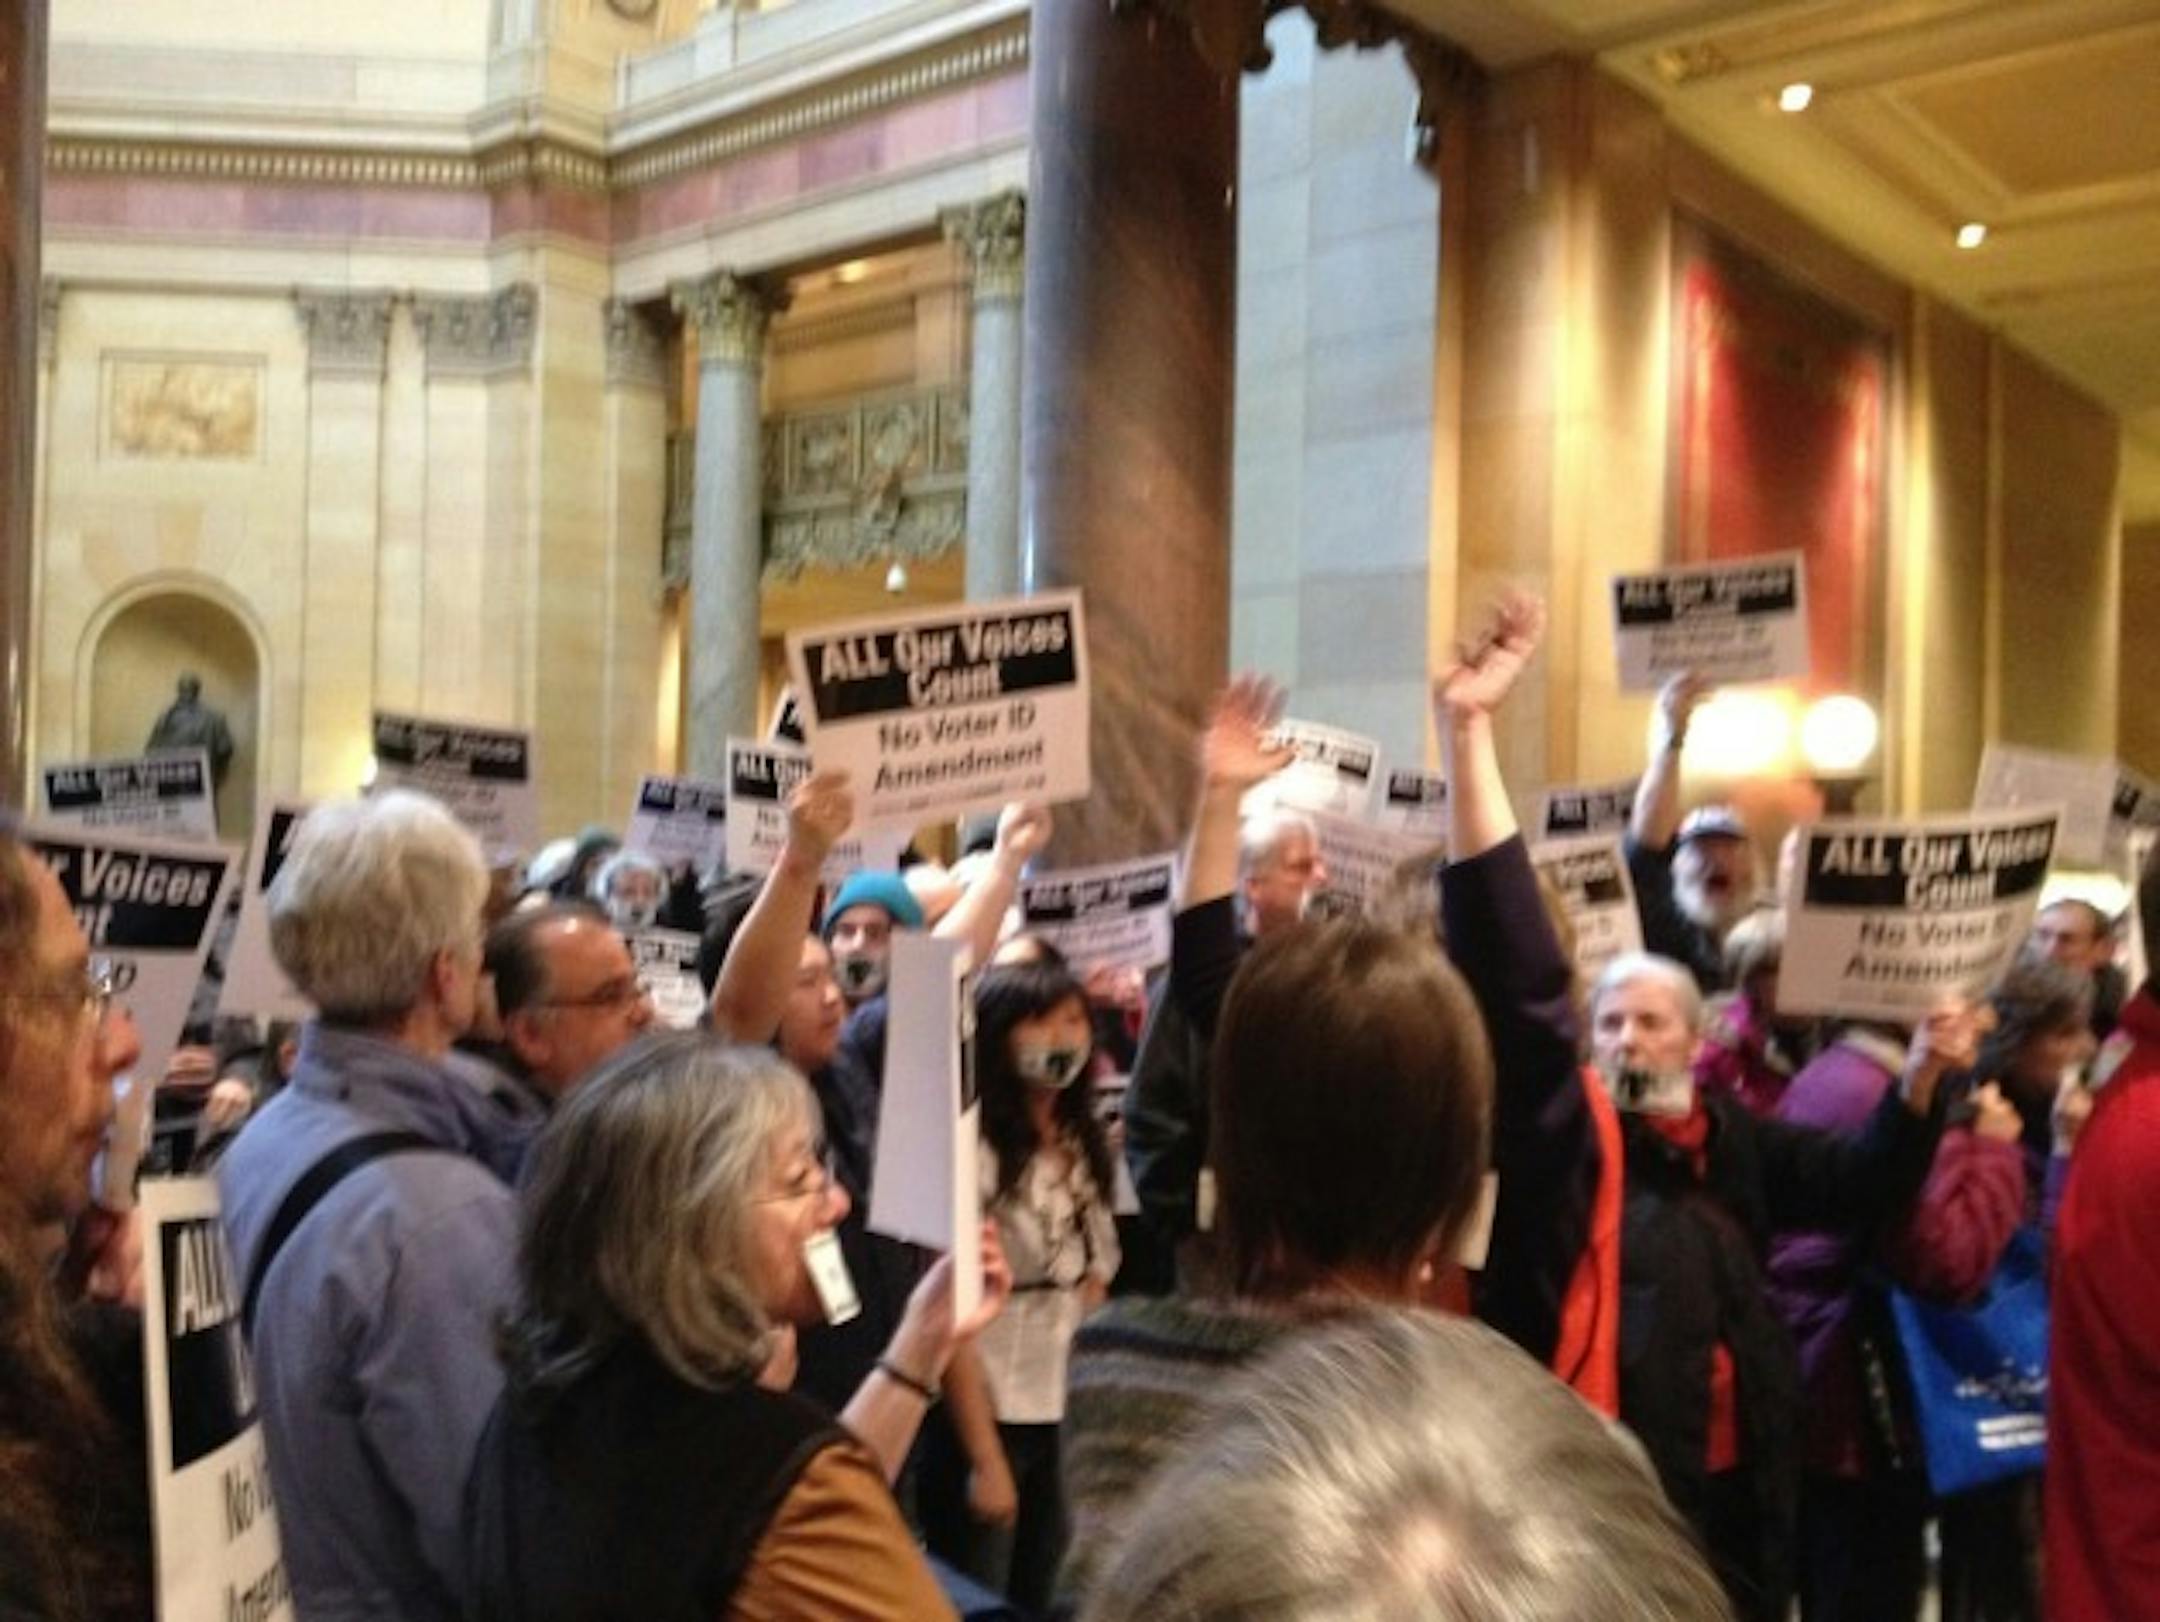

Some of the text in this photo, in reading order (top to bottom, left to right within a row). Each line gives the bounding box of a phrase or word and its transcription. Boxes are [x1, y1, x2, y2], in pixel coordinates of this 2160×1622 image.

[821, 614, 1067, 684] ALL Our Voices
[906, 660, 1001, 708] Count
[878, 702, 1036, 752] No Voter ID
[735, 753, 771, 780] ALL
[873, 739, 1044, 792] Amendment
[1821, 824, 2051, 875] ALL Our Voices
[81, 848, 211, 908] Voices
[1860, 919, 1905, 947] No
[1915, 916, 1986, 946] Voter
[174, 1223, 228, 1336] ALL
[223, 1466, 255, 1543] No
